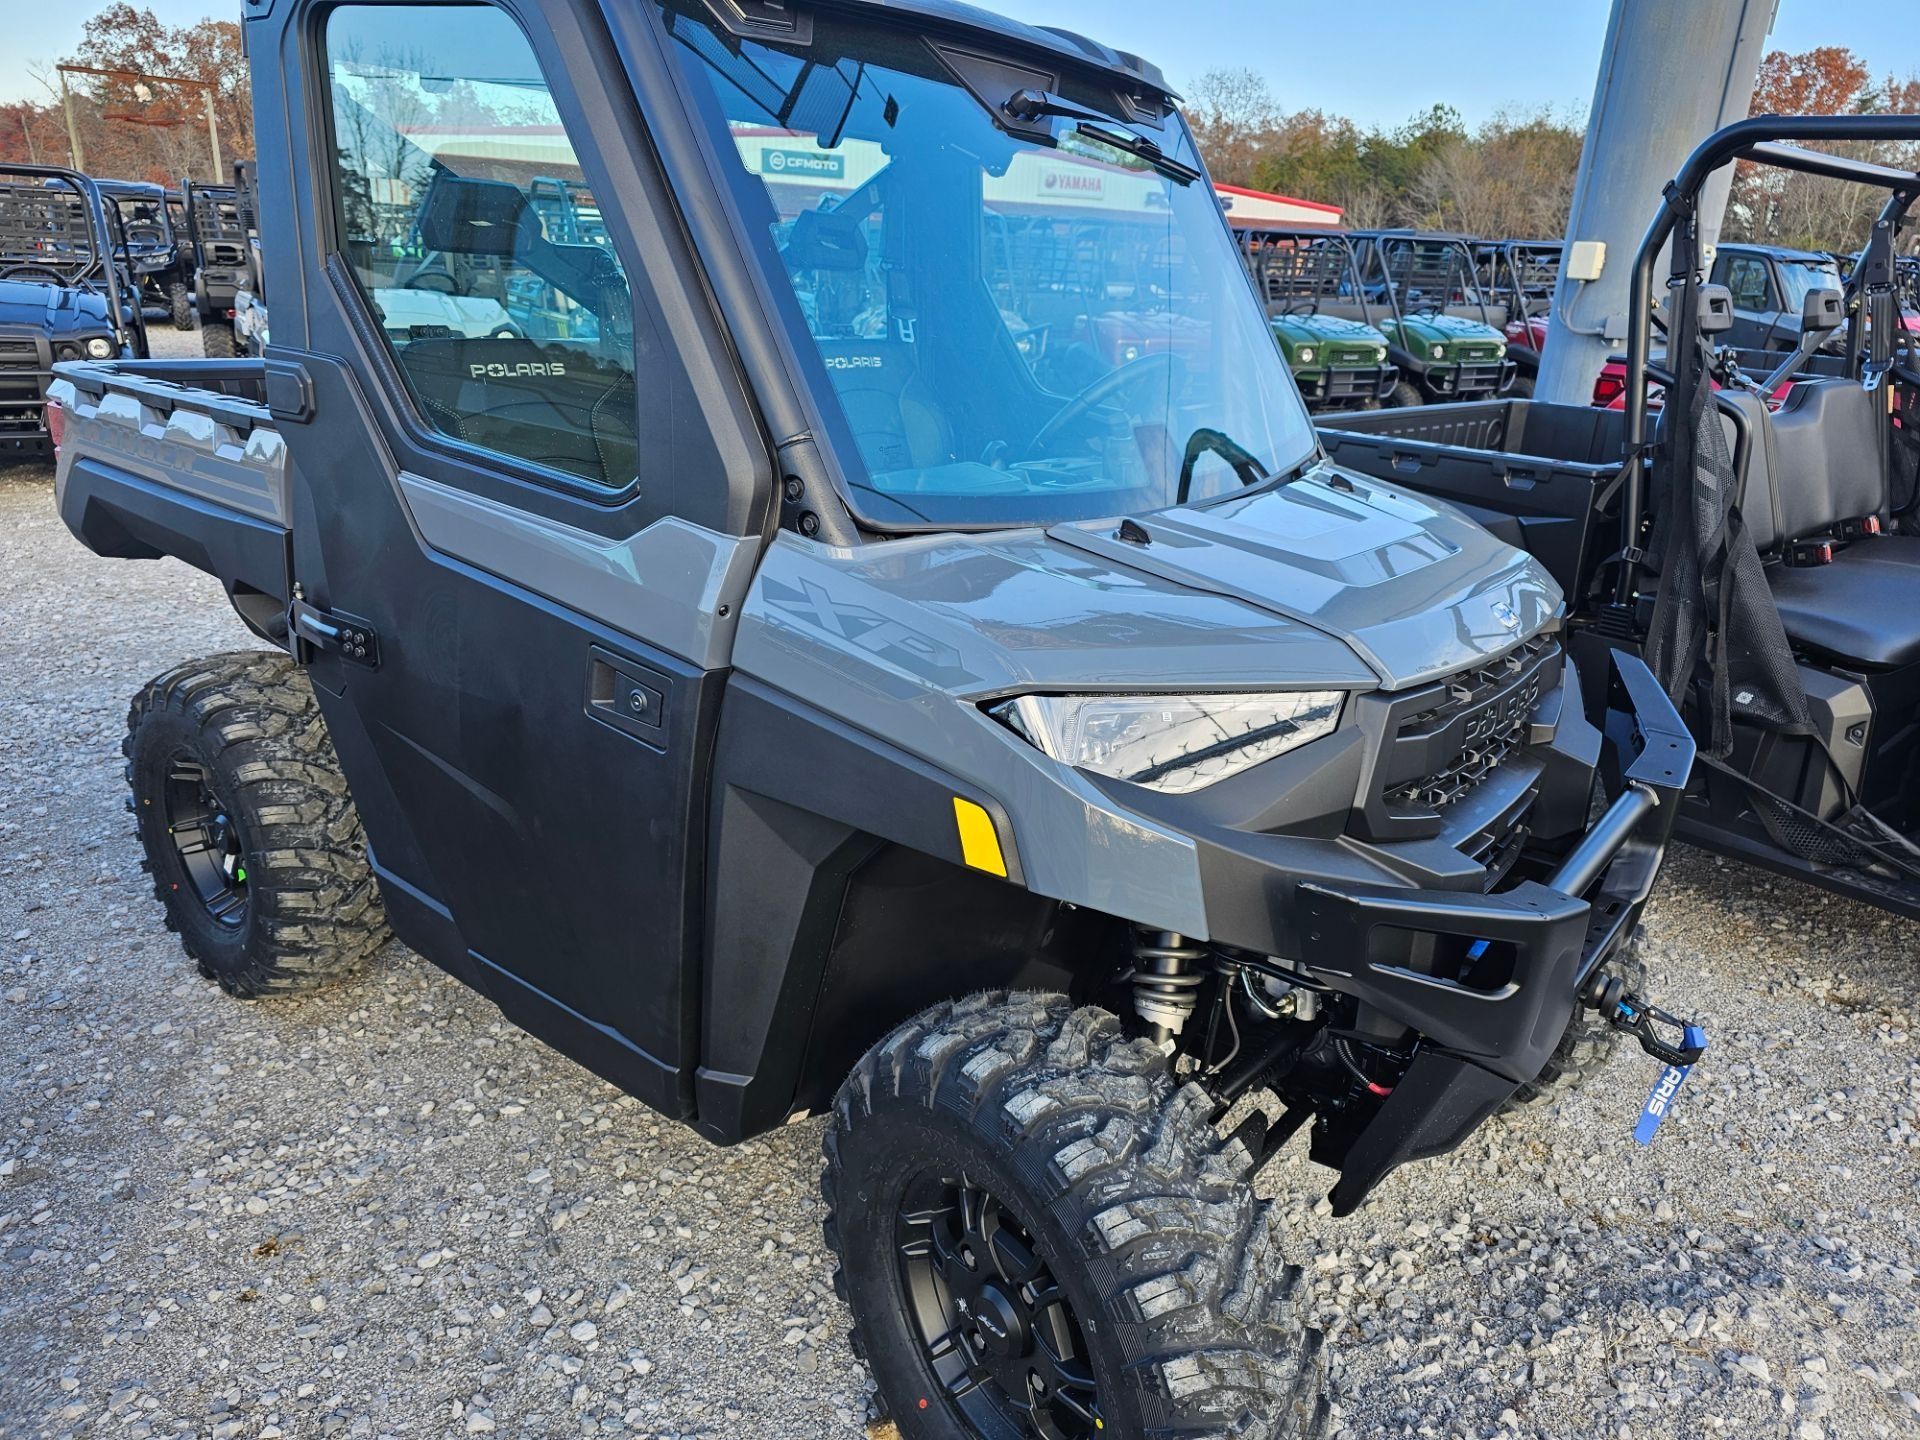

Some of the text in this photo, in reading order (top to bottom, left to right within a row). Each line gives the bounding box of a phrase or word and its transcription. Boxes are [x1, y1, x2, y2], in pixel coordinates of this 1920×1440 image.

[787, 157, 838, 171] CFMOTO
[1059, 174, 1102, 192] YAMAHA
[470, 363, 566, 378] POLARIS
[825, 356, 882, 370] POLARIS
[763, 576, 972, 688] XP
[1461, 671, 1540, 749] POLARIS
[1648, 1064, 1688, 1117] ARIS
